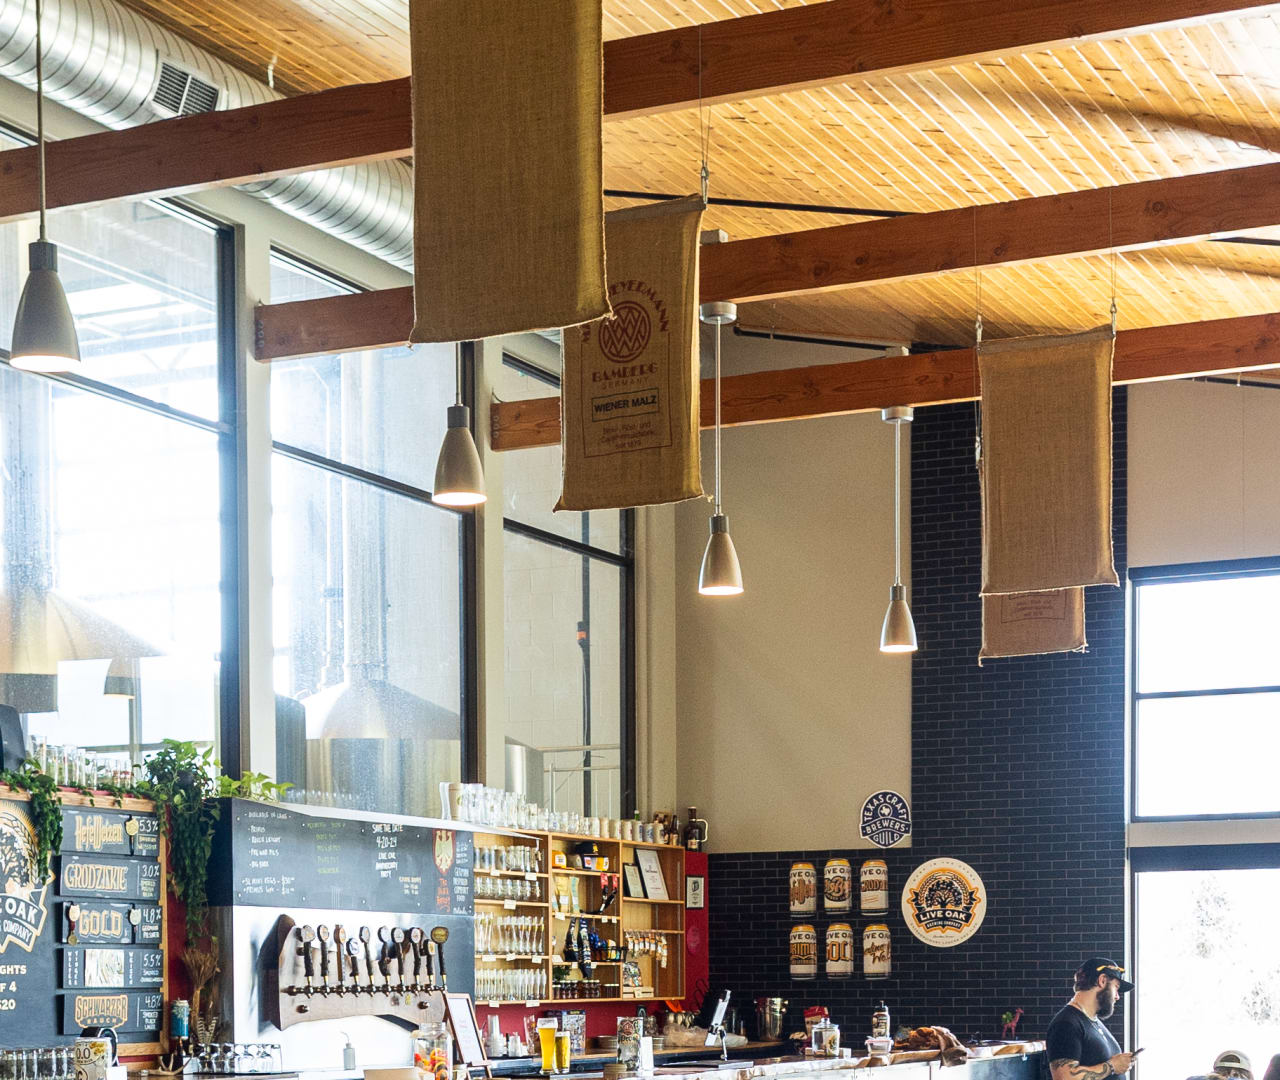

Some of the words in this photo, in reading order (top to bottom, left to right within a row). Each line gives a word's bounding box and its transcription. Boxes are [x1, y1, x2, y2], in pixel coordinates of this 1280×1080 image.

[592, 363, 658, 382] BAMBERG
[594, 400, 629, 413] WIENER
[632, 395, 657, 407] MALZ
[863, 794, 885, 822] TEXAS
[885, 794, 908, 820] CRAFT
[865, 819, 906, 834] BREWERS
[872, 831, 900, 845] GUILD
[4, 898, 38, 924] OAK
[920, 910, 943, 921] LIVE
[945, 910, 967, 921] OAK
[3, 919, 33, 943] COMPANY
[79, 909, 123, 937] GOLD
[9, 981, 17, 992] 4
